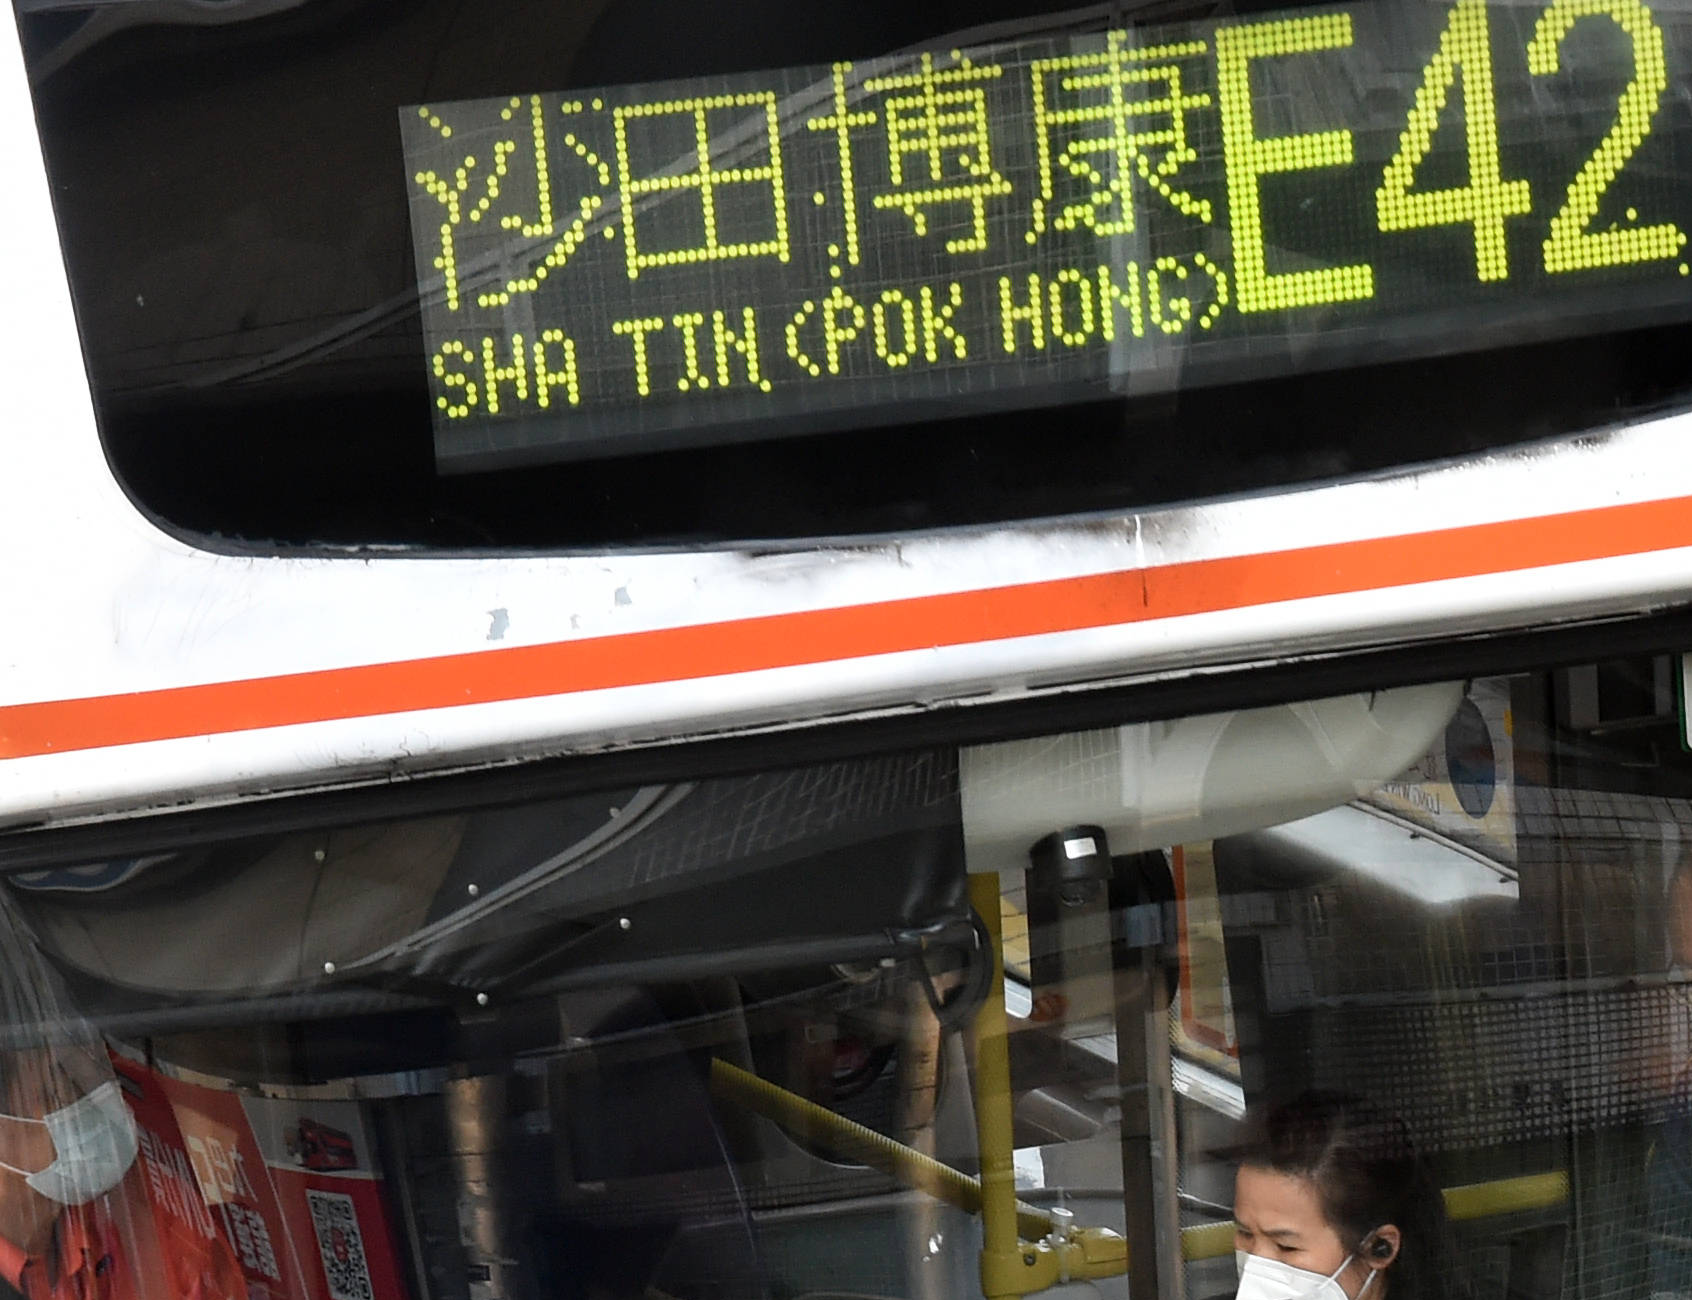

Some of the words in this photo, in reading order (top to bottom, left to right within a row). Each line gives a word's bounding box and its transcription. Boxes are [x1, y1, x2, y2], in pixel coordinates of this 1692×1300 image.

[415, 30, 1213, 310] 沙田博康
[1214, 0, 1688, 313] E42
[433, 329, 579, 418] SHA
[613, 306, 768, 396] TIN
[786, 283, 968, 376] (POK
[997, 252, 1230, 352] HONG)
